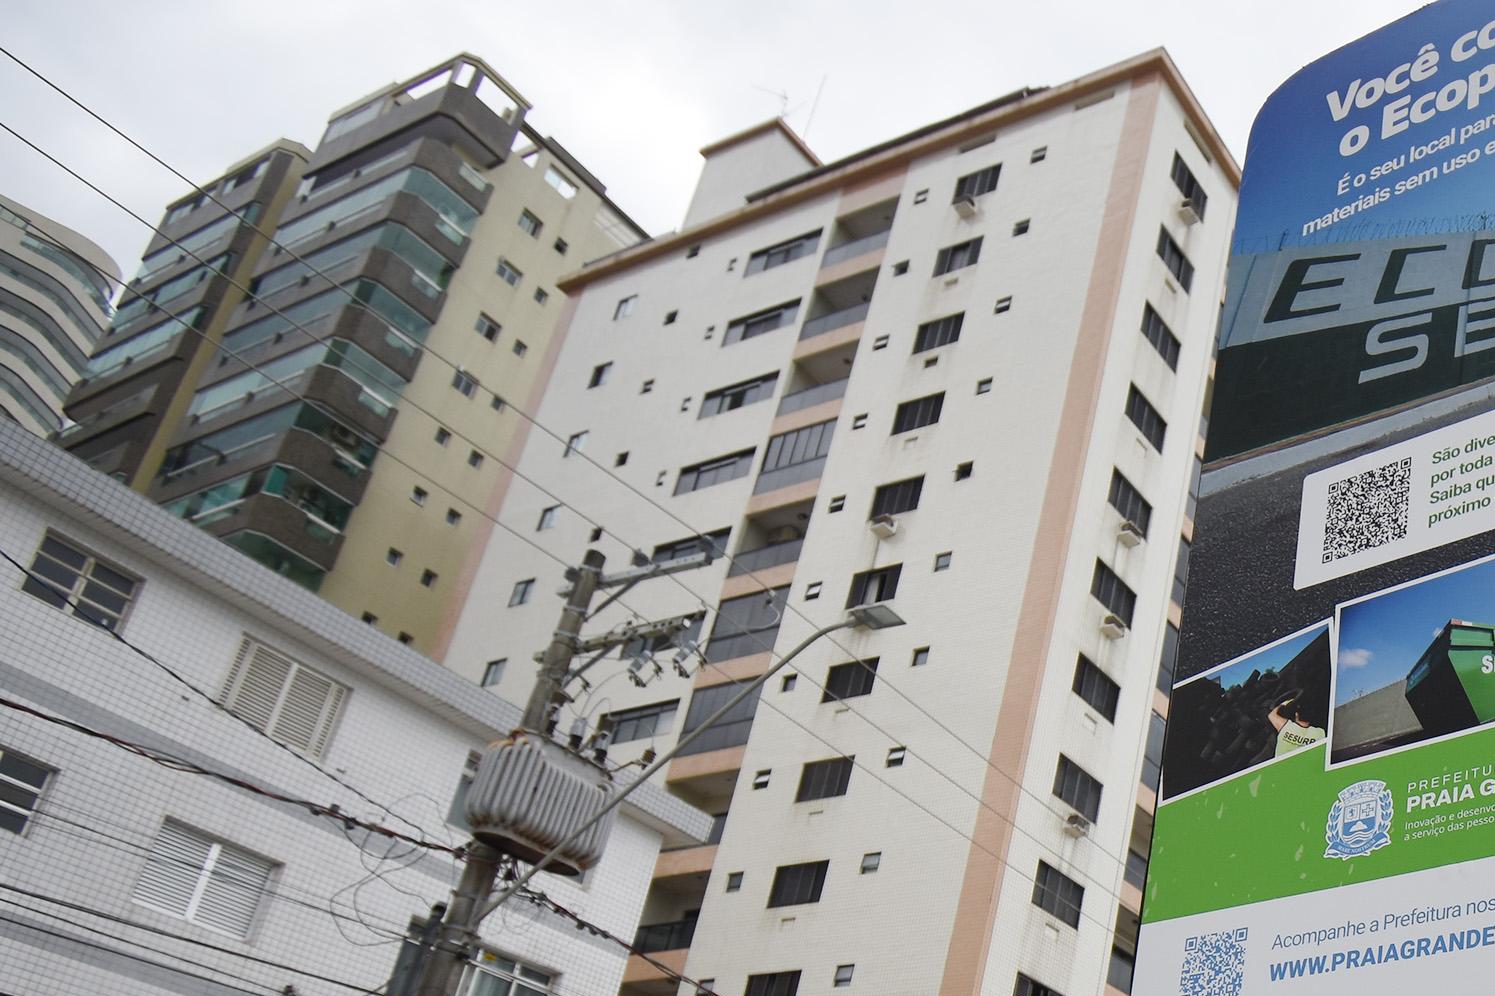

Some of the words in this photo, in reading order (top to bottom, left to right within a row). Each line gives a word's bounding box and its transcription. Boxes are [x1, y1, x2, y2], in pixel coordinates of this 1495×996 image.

[1326, 43, 1440, 122] Você
[1339, 125, 1370, 156] o
[1337, 172, 1351, 196] É
[1353, 173, 1366, 187] o
[1370, 154, 1405, 181] seu
[1409, 127, 1456, 163] local
[1303, 187, 1390, 236] materiais
[1394, 166, 1438, 195] sem
[1442, 148, 1480, 174] uso
[1430, 468, 1455, 488] por
[1460, 455, 1493, 475] toda
[1431, 447, 1460, 465] São
[1430, 481, 1472, 504] Saiba
[1428, 496, 1491, 528] próximo
[1406, 783, 1475, 813] PRAIA
[1404, 833, 1410, 841] a
[1412, 826, 1445, 839] serviço
[1447, 822, 1464, 832] das
[1405, 815, 1446, 830] Inovação
[1271, 920, 1366, 950] Acompanhe
[1369, 920, 1379, 932] a
[1383, 904, 1461, 930] Prefeitura
